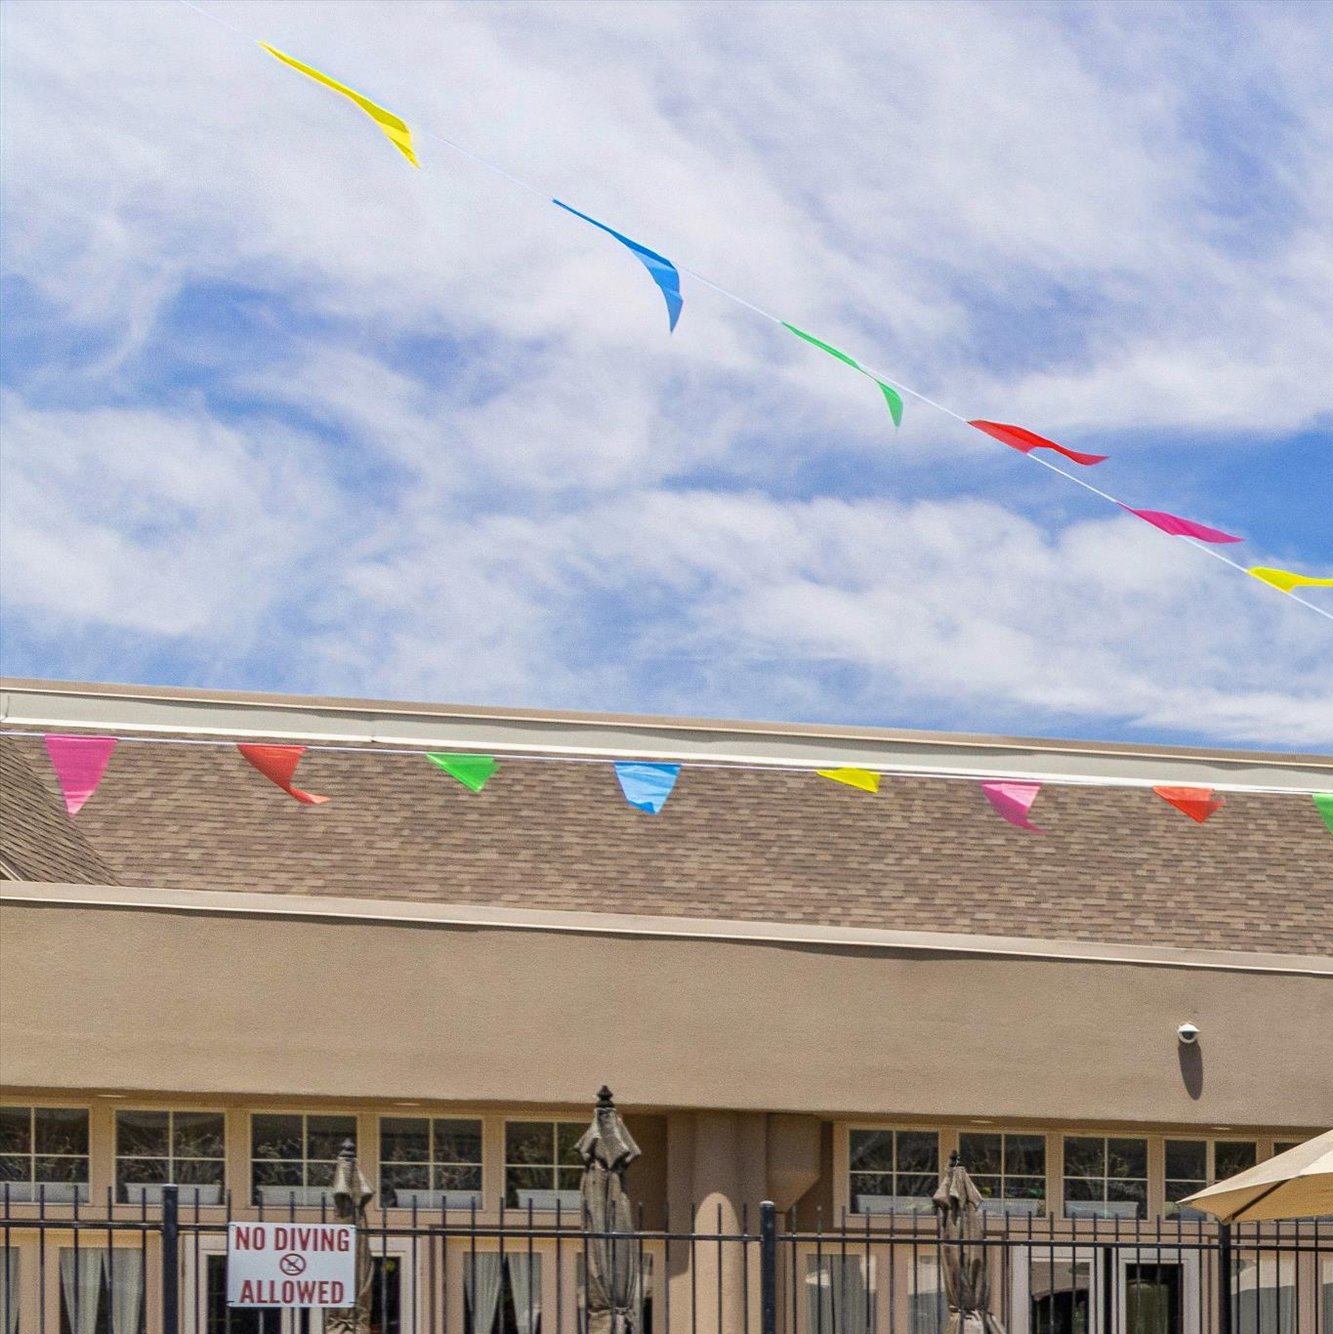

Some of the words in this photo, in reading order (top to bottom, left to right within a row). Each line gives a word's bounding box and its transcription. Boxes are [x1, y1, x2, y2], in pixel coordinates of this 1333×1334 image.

[235, 1226, 266, 1251] NO
[274, 1227, 350, 1252] DIVING
[239, 1279, 344, 1304] ALLOWED
